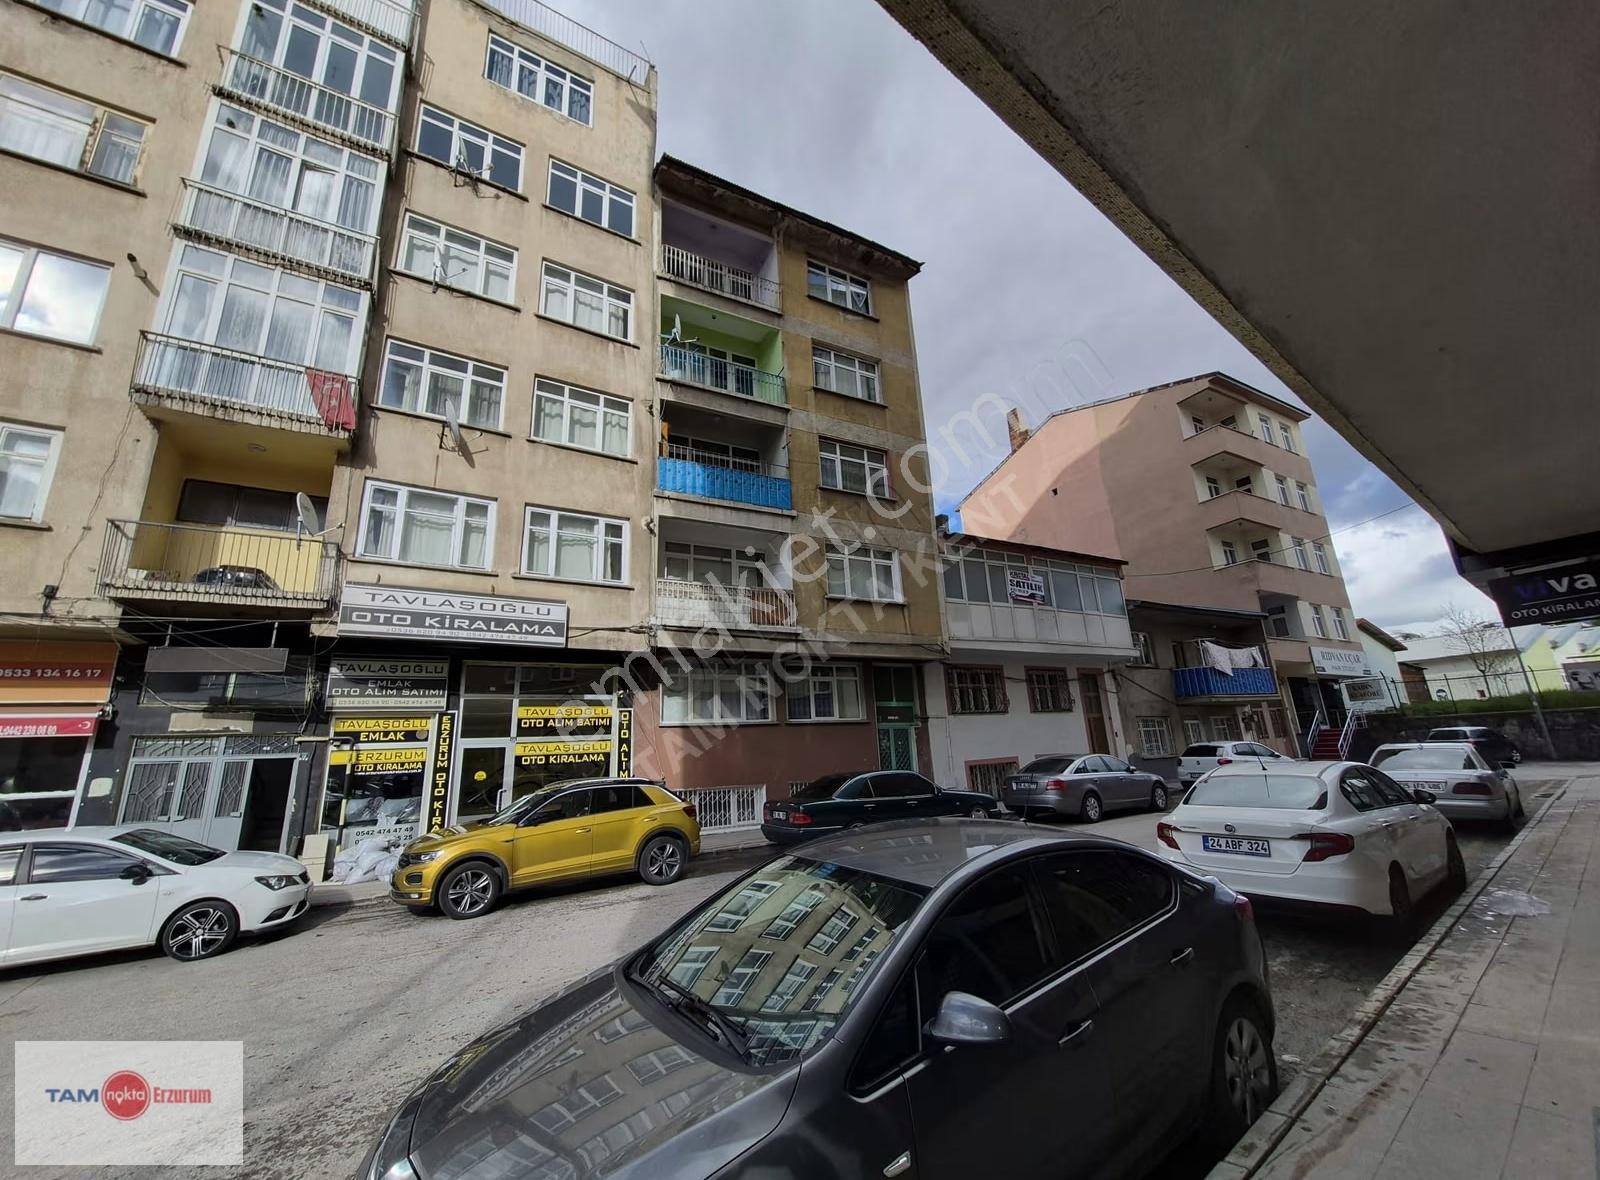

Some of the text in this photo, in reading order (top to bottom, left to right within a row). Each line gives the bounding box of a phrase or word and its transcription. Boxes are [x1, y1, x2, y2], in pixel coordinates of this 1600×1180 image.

[1009, 579, 1044, 593] SATILIK
[1511, 608, 1539, 618] OTO
[352, 611, 556, 635] OTO KİRALAMA
[36, 669, 60, 677] 134
[65, 669, 81, 677] 16
[86, 669, 102, 677] 17
[337, 662, 444, 674] TAVLAŞOĞLU
[523, 708, 609, 717] TAVLAŞOĞLU
[340, 718, 428, 730] TAVLAŞOĞLU
[521, 718, 609, 727] OTO ALIM SATIMI
[360, 732, 406, 741] EMLAK
[437, 715, 451, 768] ERZURUM
[620, 712, 629, 779] OTO ALIM
[356, 752, 424, 762] ERZURUM
[522, 756, 545, 765] OTO
[354, 764, 374, 772] OTO
[434, 773, 446, 796] OTO
[1209, 838, 1268, 852] 24 ABF 324
